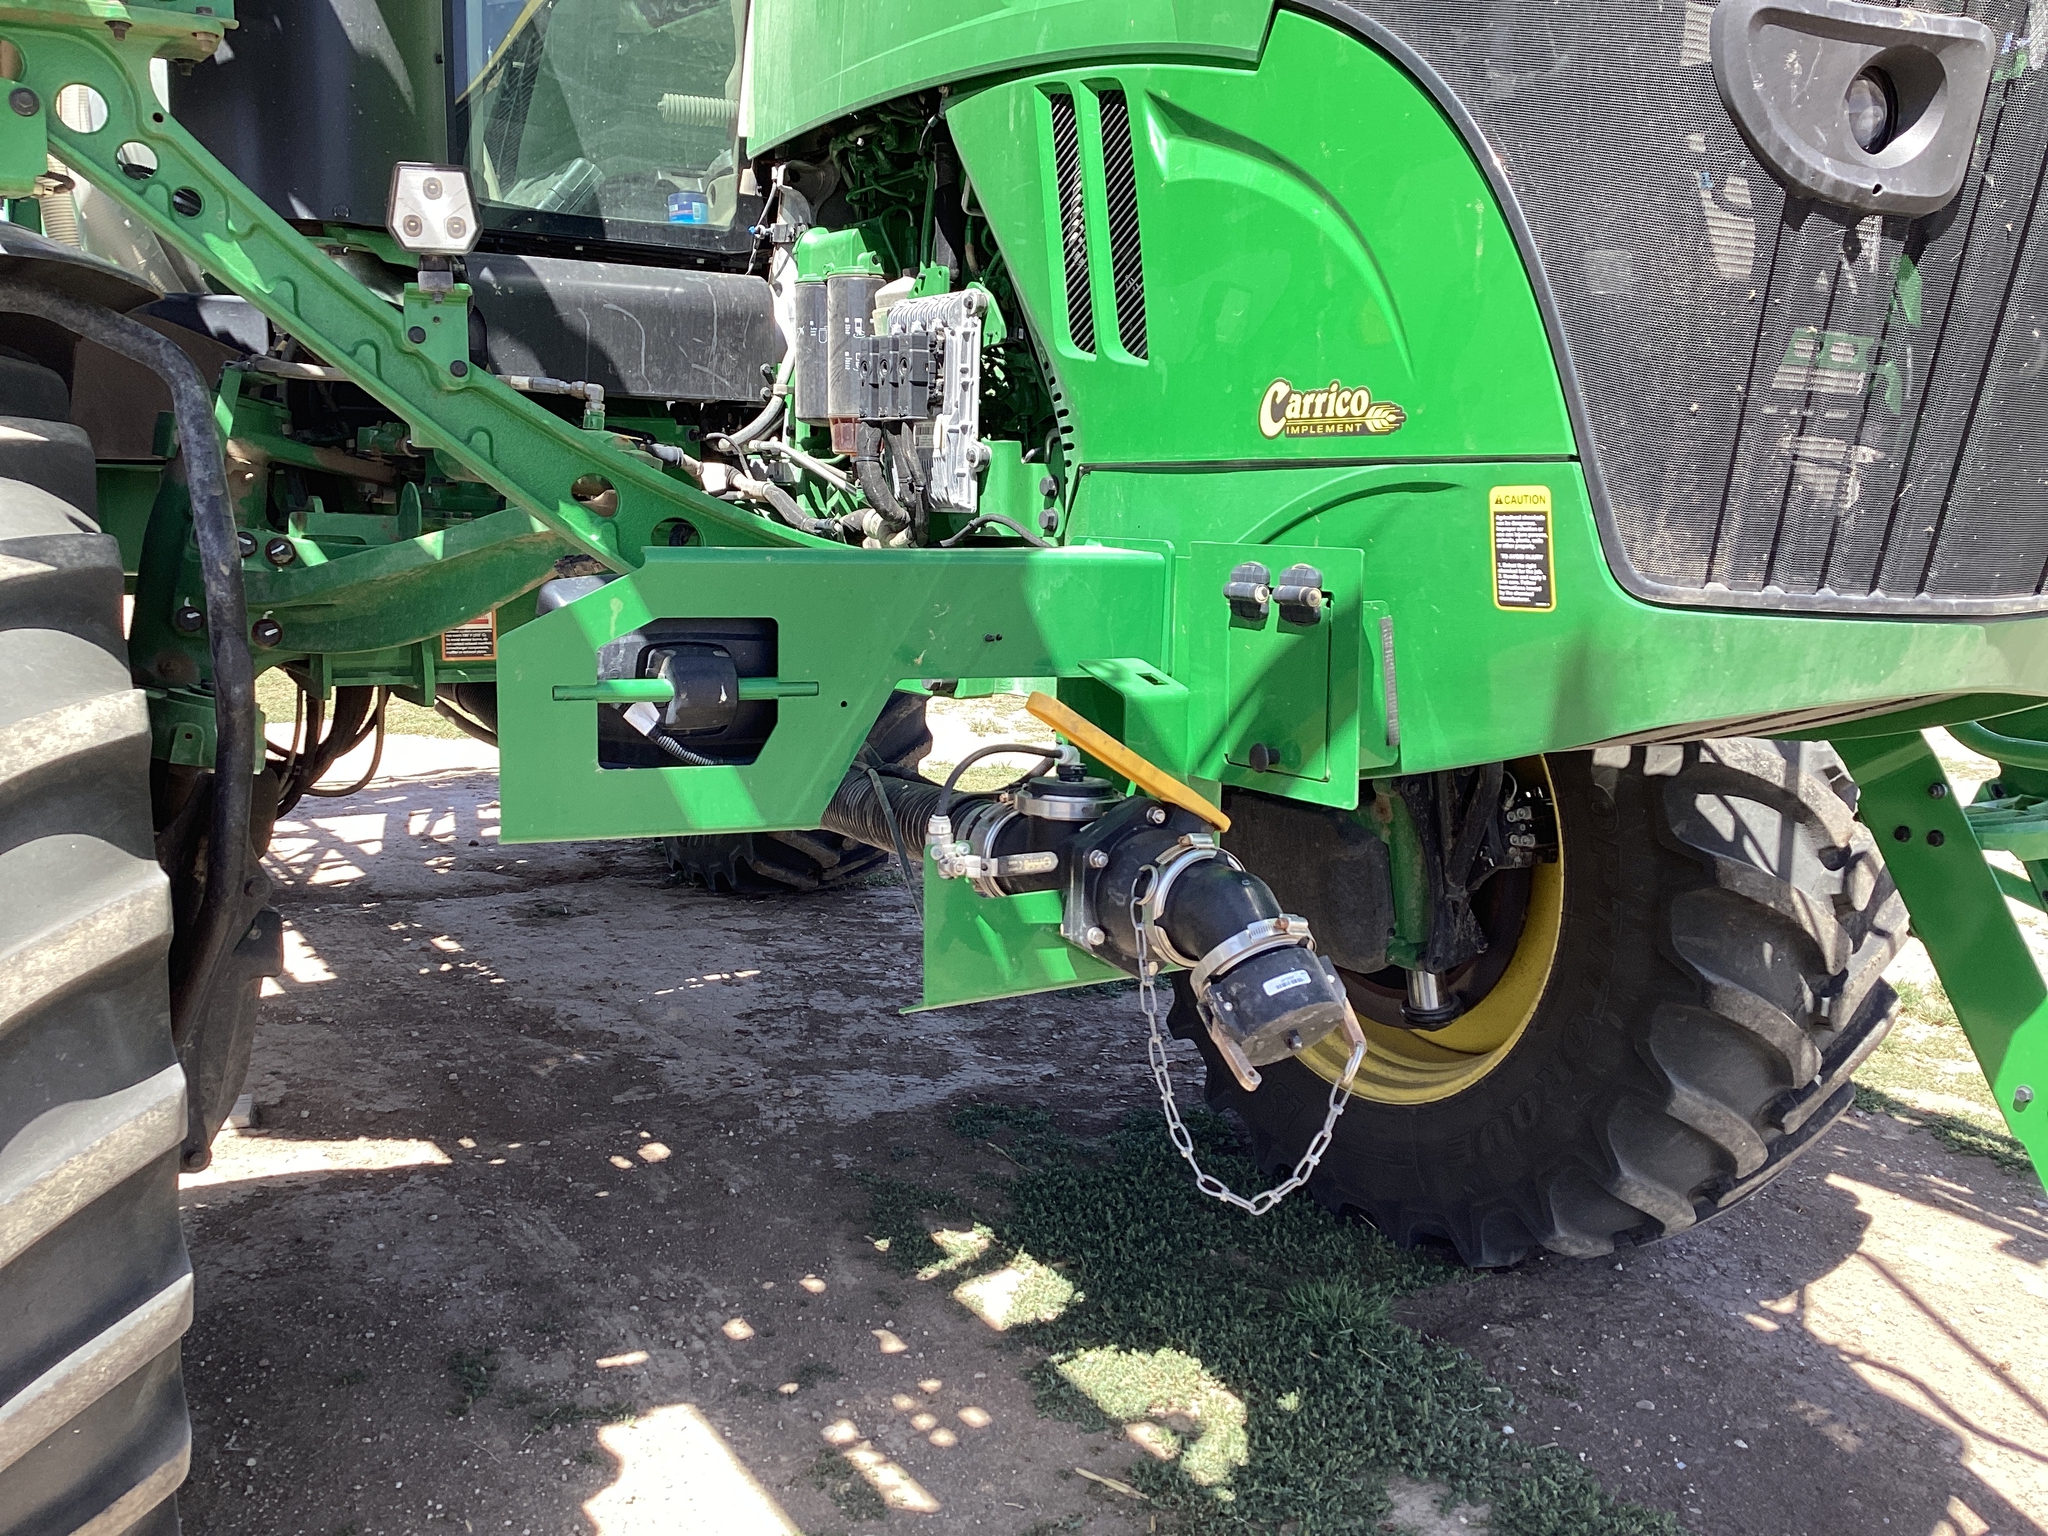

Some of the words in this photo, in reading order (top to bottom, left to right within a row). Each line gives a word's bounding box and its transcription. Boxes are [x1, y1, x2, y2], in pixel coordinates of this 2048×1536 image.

[1259, 380, 1370, 437] Carrico
[1286, 423, 1362, 435] IMPLEMENT
[1504, 494, 1546, 505] CAUTION
